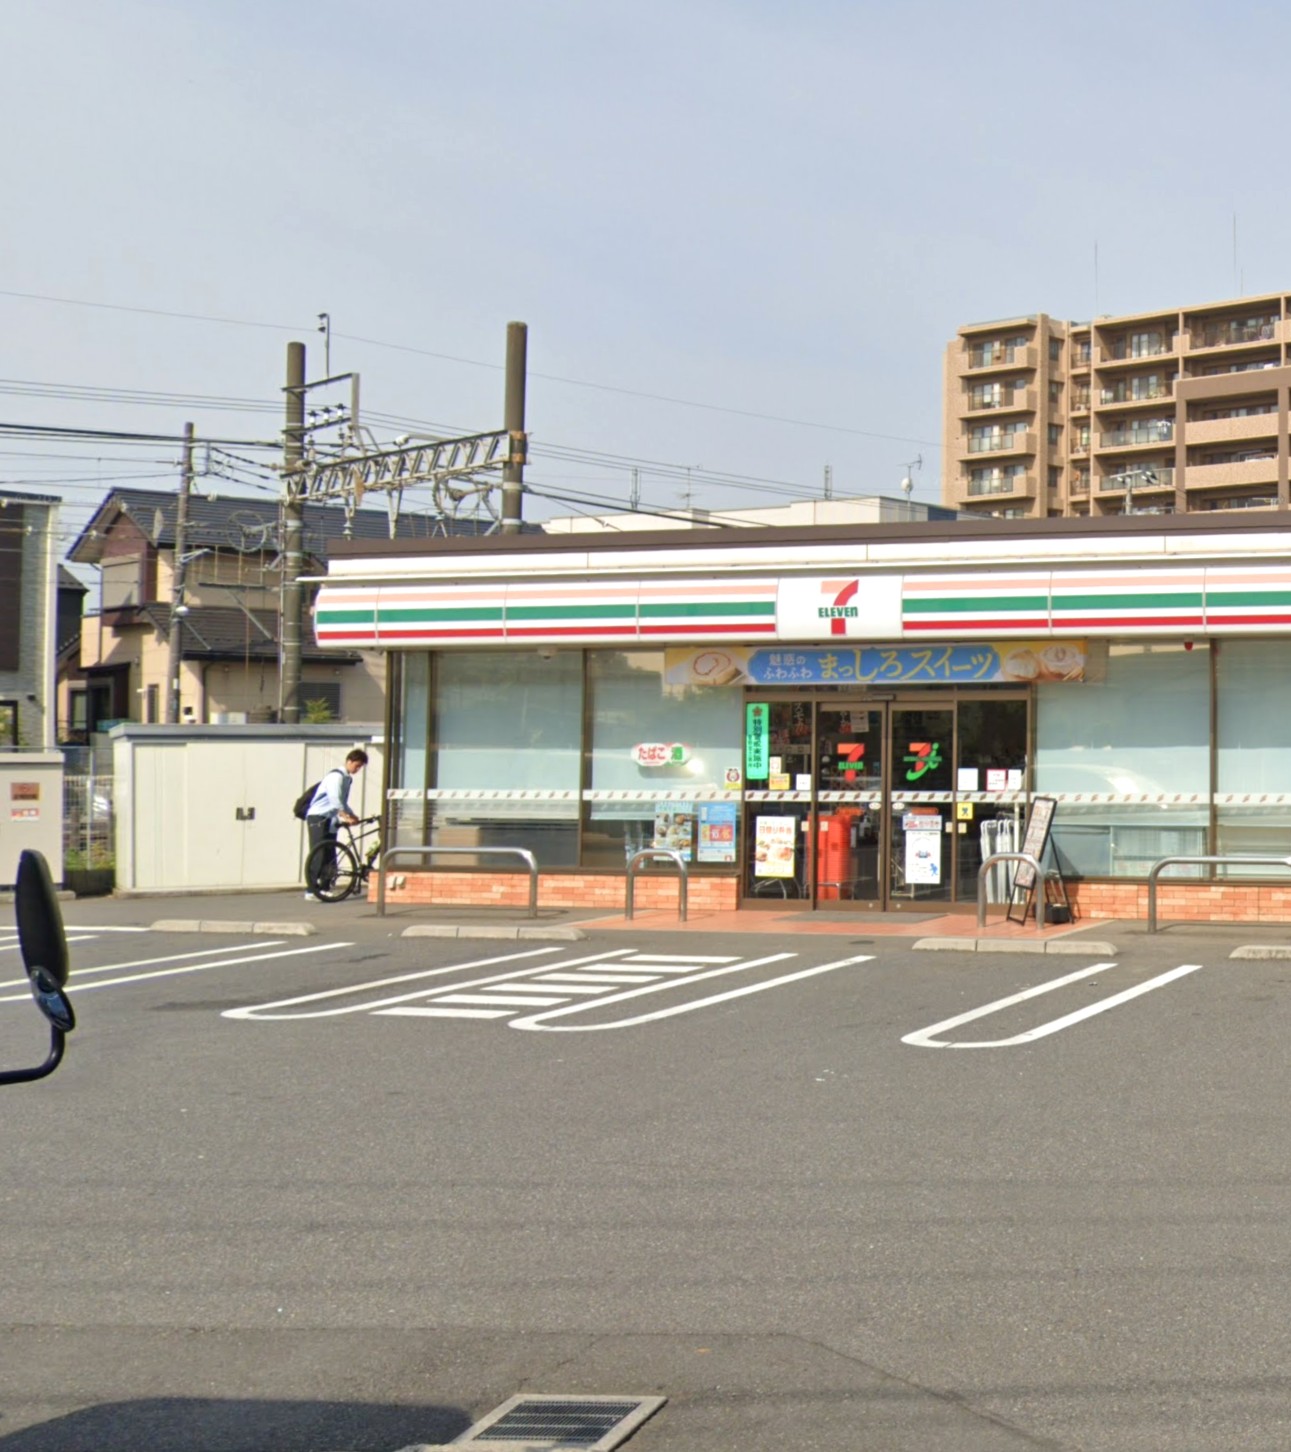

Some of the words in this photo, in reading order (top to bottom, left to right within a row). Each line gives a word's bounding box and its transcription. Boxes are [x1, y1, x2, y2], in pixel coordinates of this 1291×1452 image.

[818, 648, 993, 682] まっしろスイーツ
[763, 667, 812, 680] ふわふわ
[639, 746, 666, 760] たばこ
